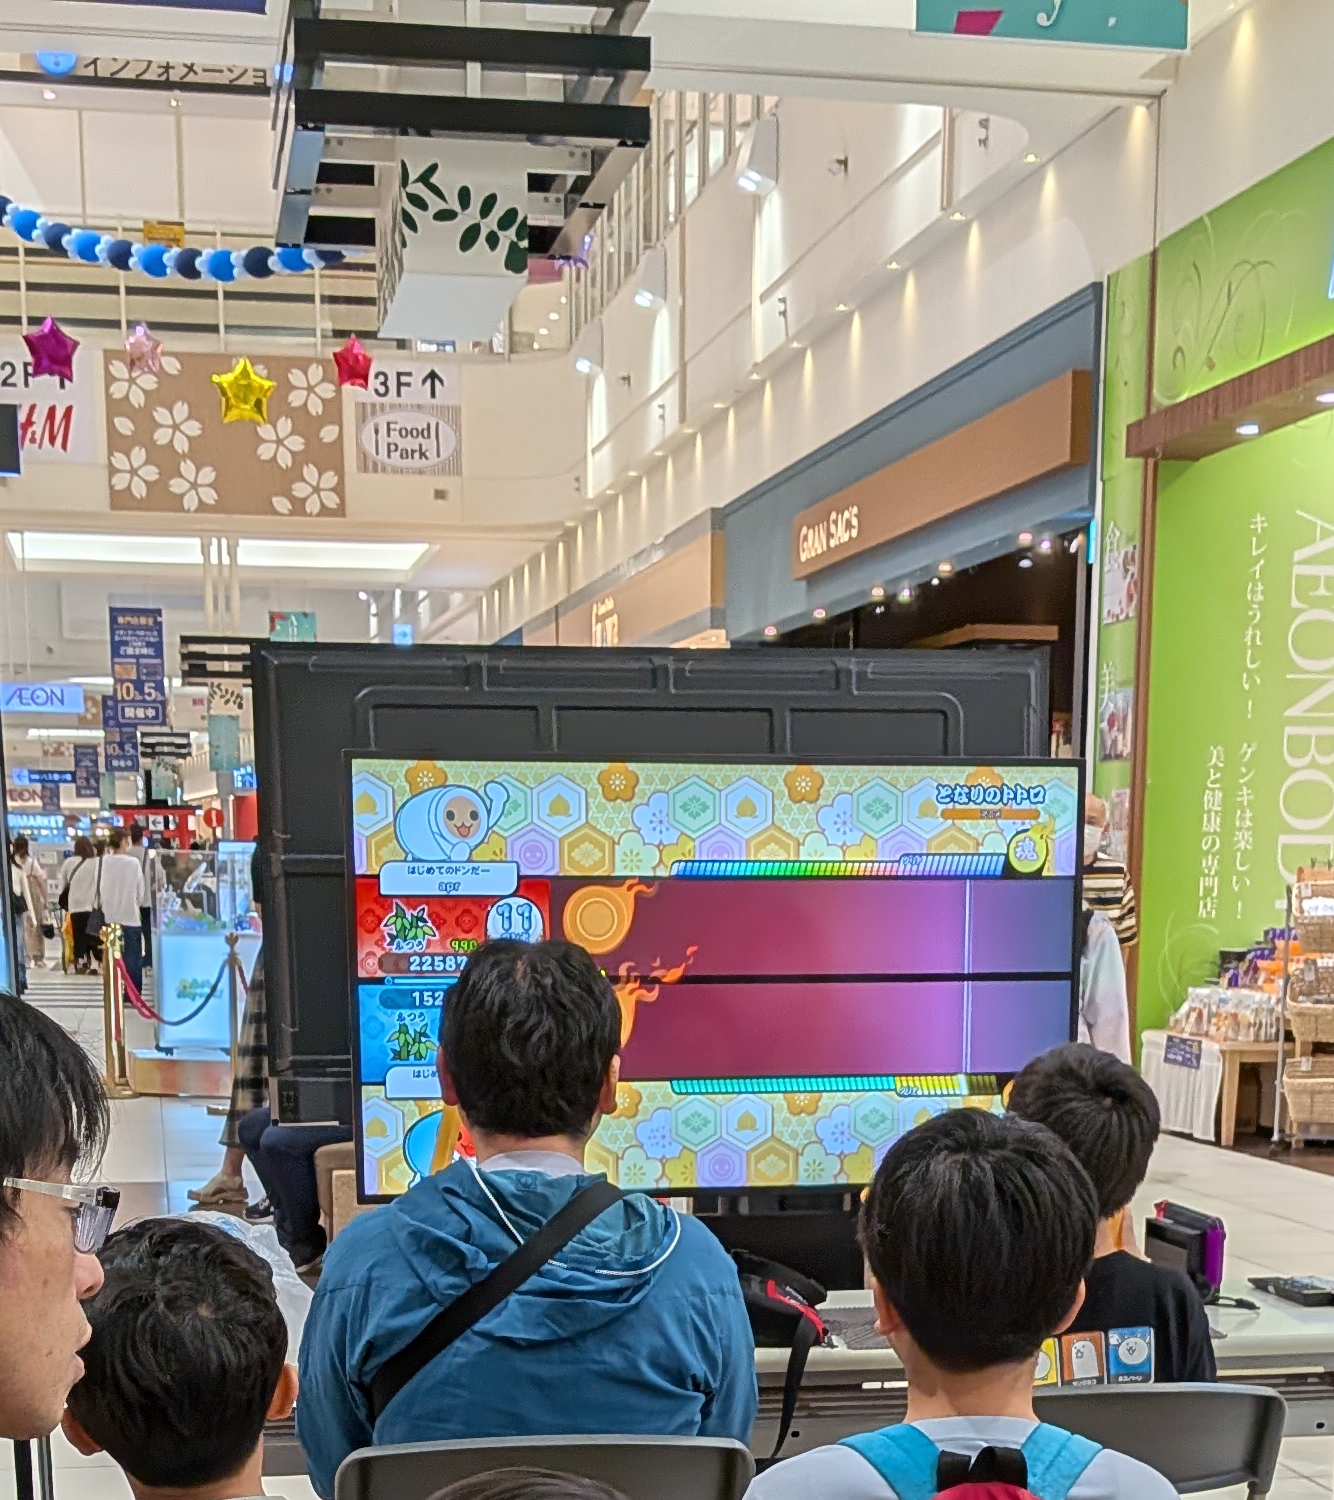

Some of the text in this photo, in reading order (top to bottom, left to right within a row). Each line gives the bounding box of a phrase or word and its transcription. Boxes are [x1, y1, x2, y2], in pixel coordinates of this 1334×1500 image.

[373, 371, 413, 398] 3F
[386, 421, 431, 440] Food
[386, 442, 429, 460] Park
[936, 783, 1046, 805] となりのトトロ
[407, 865, 490, 876] はじめてのドンだー
[496, 902, 533, 932] 11
